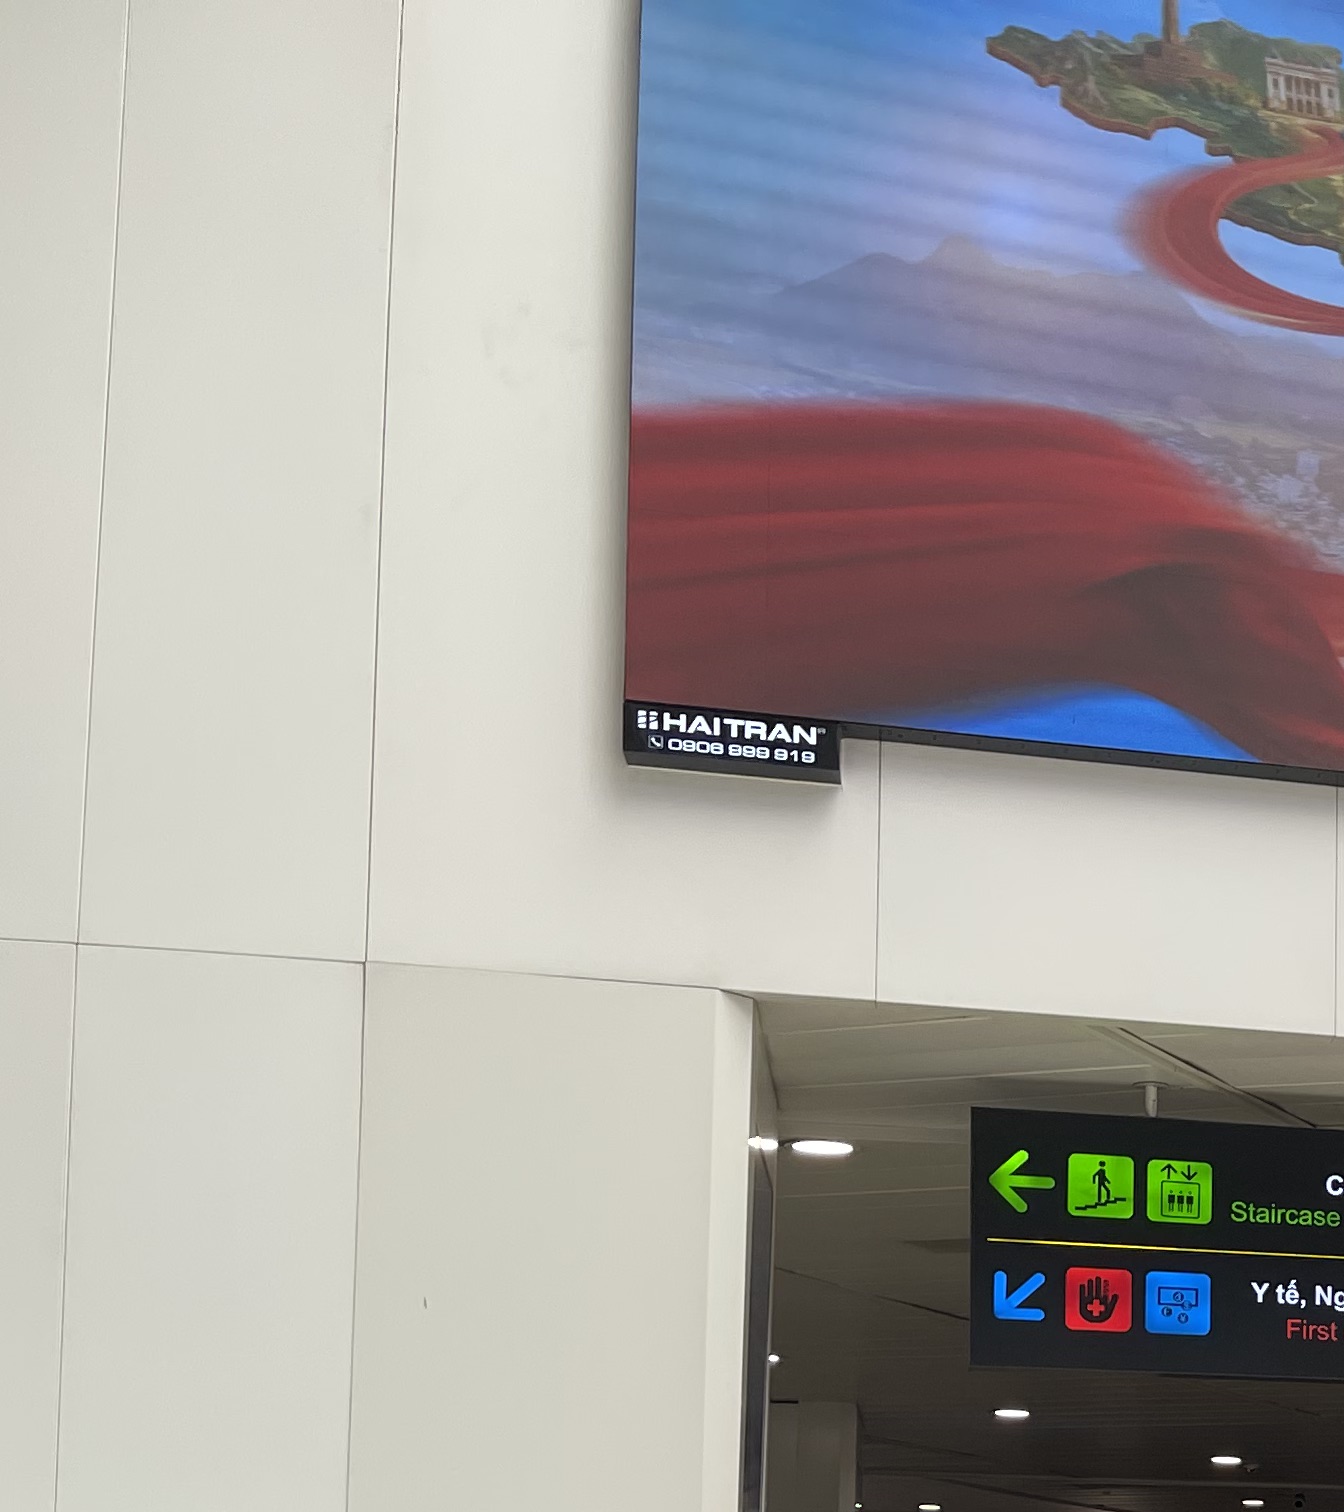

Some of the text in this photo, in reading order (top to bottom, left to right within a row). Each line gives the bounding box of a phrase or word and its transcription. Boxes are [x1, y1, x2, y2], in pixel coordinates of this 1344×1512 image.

[1230, 1200, 1341, 1228] Staircase
[1250, 1282, 1270, 1305] Y
[1275, 1280, 1306, 1308] tế,
[1286, 1318, 1338, 1342] First
